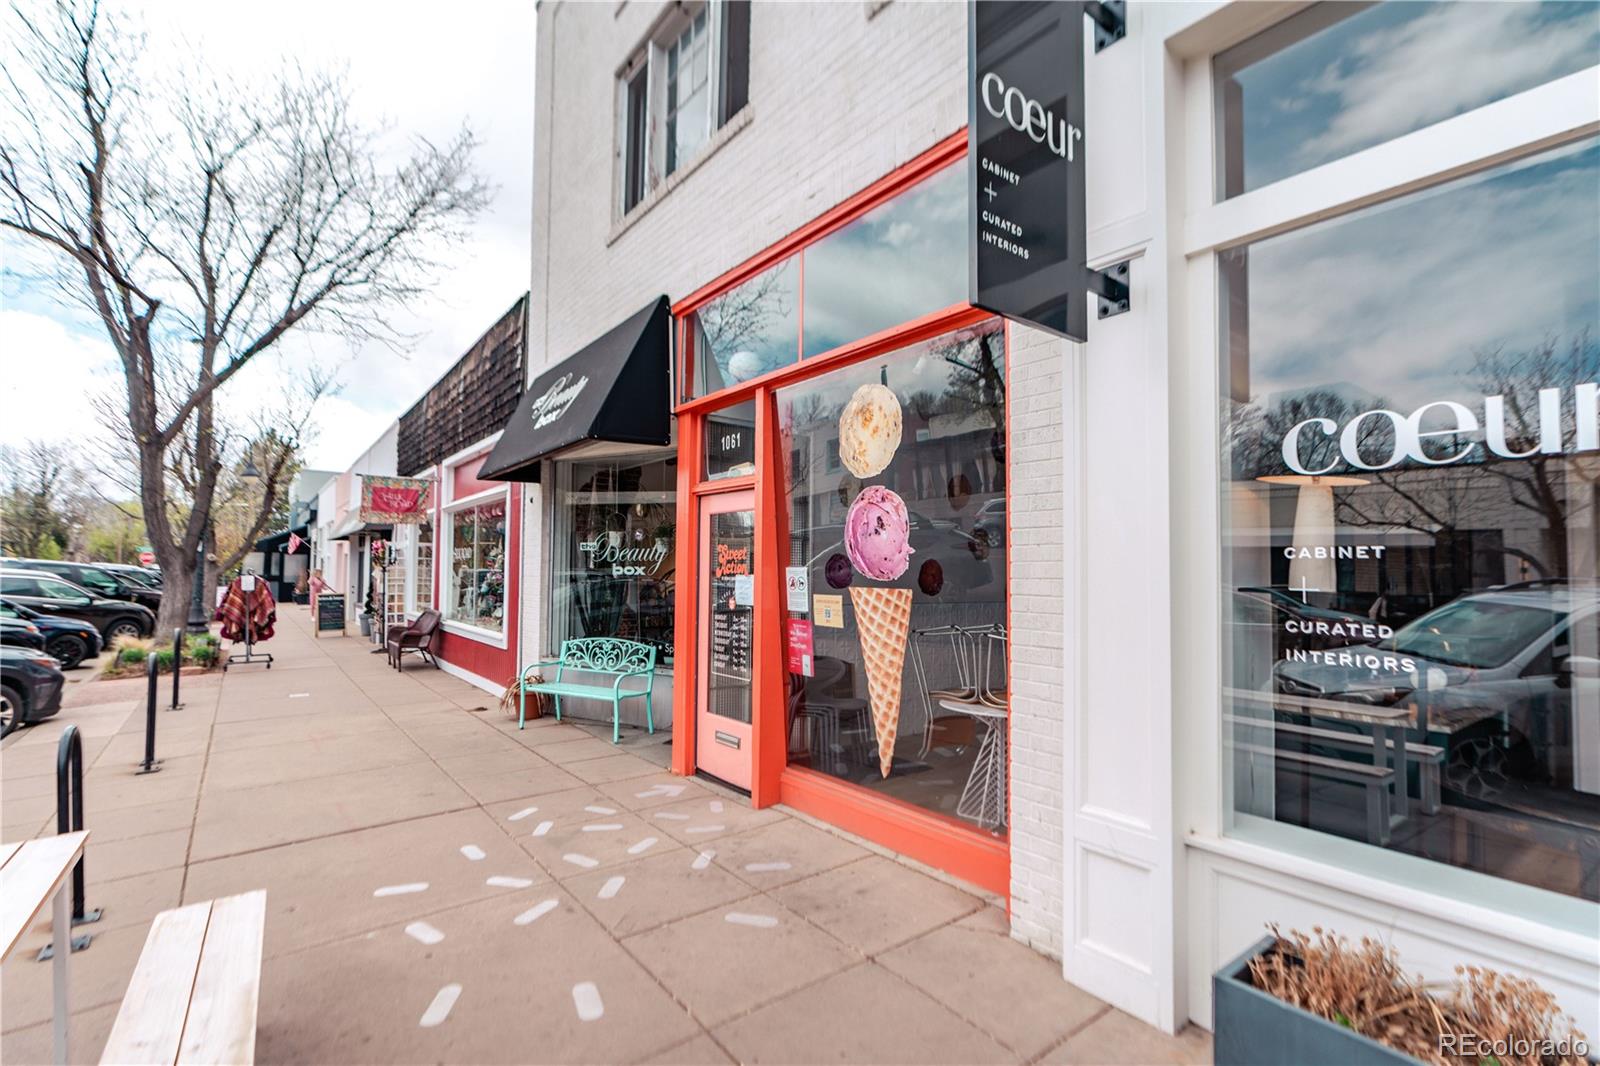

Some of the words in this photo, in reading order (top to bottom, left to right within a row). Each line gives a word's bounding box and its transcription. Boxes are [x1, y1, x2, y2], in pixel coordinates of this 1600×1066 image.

[982, 157, 1020, 186] CABINET
[982, 210, 1023, 237] CURATED
[982, 231, 1030, 260] INTERIORS
[721, 432, 741, 451] 1061
[593, 531, 667, 576] Beauty
[717, 544, 748, 564] Sweet
[1284, 545, 1386, 559] CABINET
[612, 563, 647, 578] box
[715, 561, 749, 578] Action
[1285, 619, 1394, 640] CURATED
[1285, 648, 1417, 673] INTERIORS
